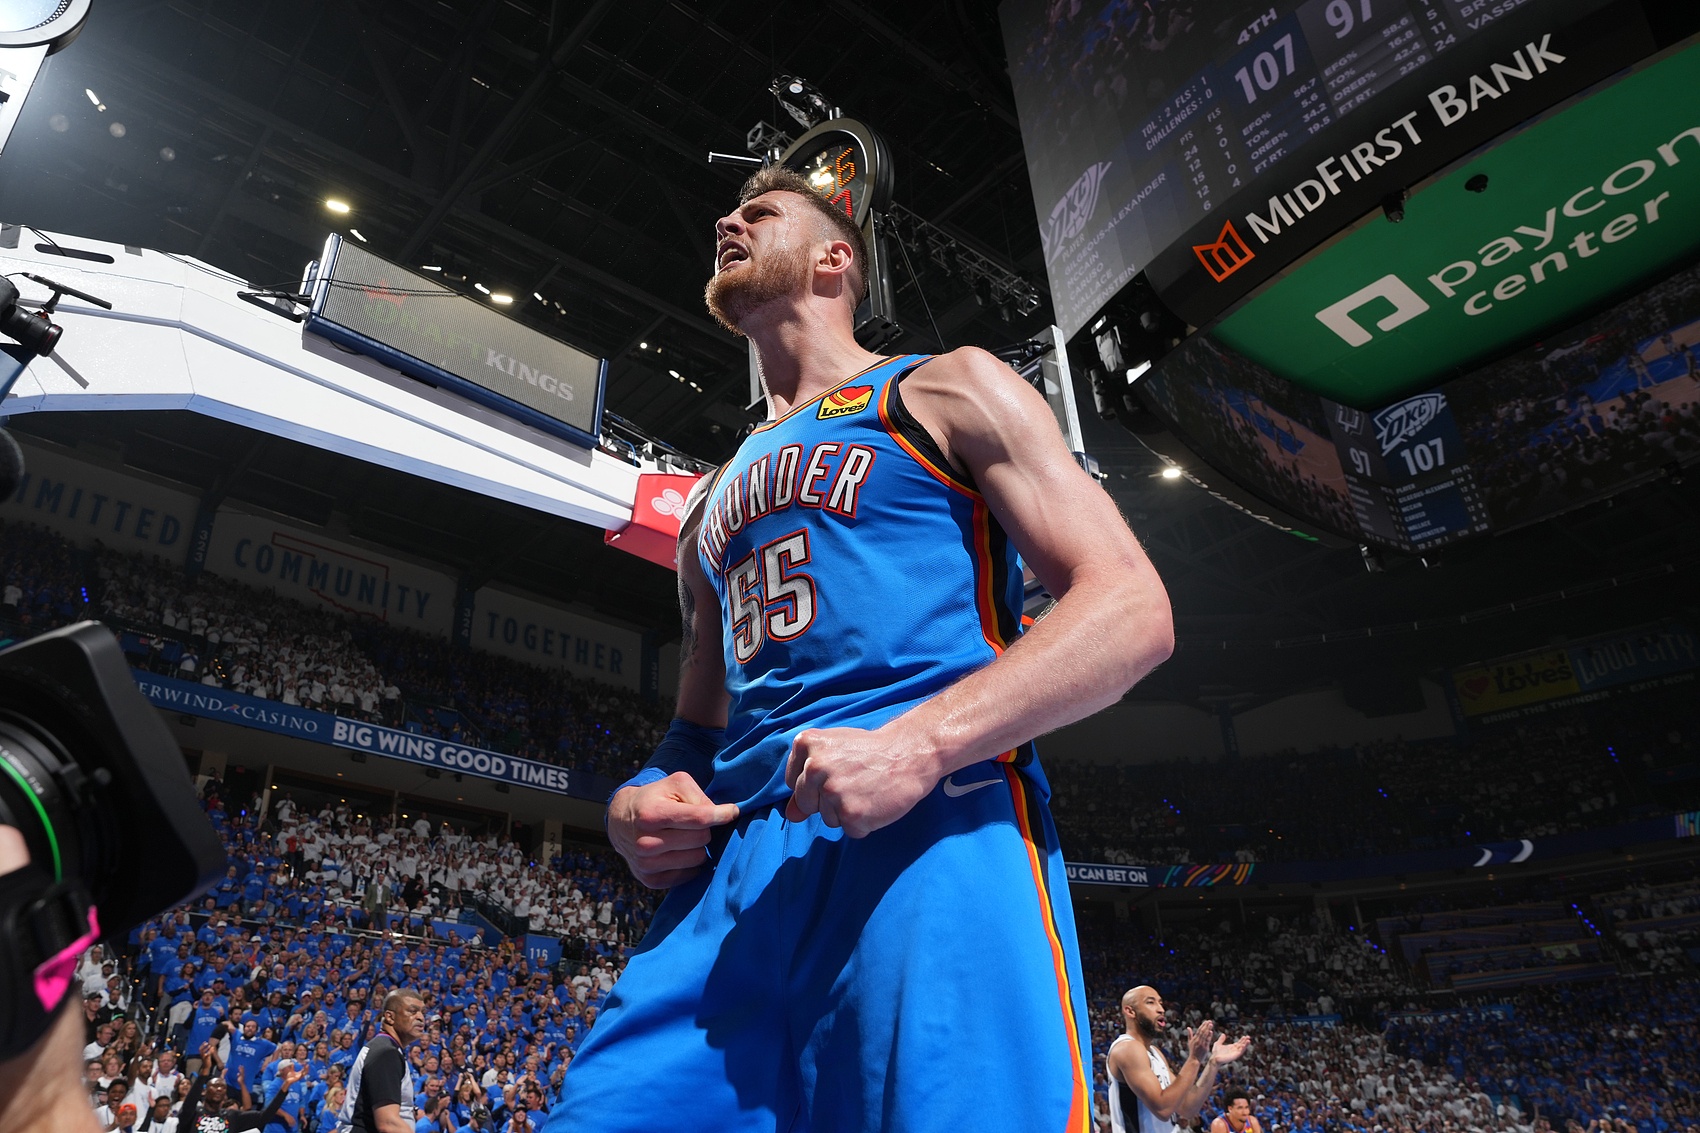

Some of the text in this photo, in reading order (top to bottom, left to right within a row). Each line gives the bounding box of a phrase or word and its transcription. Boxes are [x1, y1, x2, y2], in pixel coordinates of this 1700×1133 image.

[1426, 8, 1438, 21] 5
[1236, 7, 1278, 45] 4TH
[1431, 21, 1447, 35] 11
[1434, 33, 1456, 52] 24
[1234, 32, 1296, 104] 107
[1323, 51, 1358, 77] EFG%
[1293, 78, 1317, 98] 56.7
[1328, 68, 1356, 89] TO%
[1334, 71, 1377, 102] OREB%
[1164, 106, 1171, 118] 2
[1201, 76, 1207, 85] 1
[1207, 107, 1222, 123] FLS
[1302, 103, 1328, 123] 34.2
[1338, 101, 1354, 115] FT
[1215, 124, 1223, 135] 3
[1242, 112, 1272, 136] EFG%
[1308, 116, 1331, 135] 19.5
[1179, 130, 1194, 146] PTS
[1219, 137, 1228, 148] 0
[1246, 128, 1270, 148] TO%
[1251, 130, 1288, 160] OREB%
[1184, 144, 1198, 162] 24
[1224, 151, 1231, 160] 1
[1188, 158, 1202, 172] 12
[1228, 163, 1237, 175] 0
[1254, 161, 1267, 174] FT
[1192, 171, 1205, 186] 15
[1232, 177, 1241, 188] 4
[1196, 184, 1210, 199] 12
[1203, 200, 1211, 211] 6
[1065, 172, 1167, 276] GILGEOUS-ALEXANDER
[1463, 190, 1670, 317] center
[1349, 447, 1373, 478] 97
[1400, 437, 1446, 476] 107
[700, 442, 876, 575] THUNDER
[235, 538, 431, 619] COMMUNITY
[725, 528, 817, 665] 55
[487, 610, 624, 675] TOGETHER
[136, 679, 318, 733] ERWIND CASINO
[1524, 704, 1547, 716] THE
[1551, 690, 1610, 710] THUNDER
[332, 721, 569, 790] BIG WINS GOOD TIMES
[1066, 866, 1148, 884] U CAN BET ON
